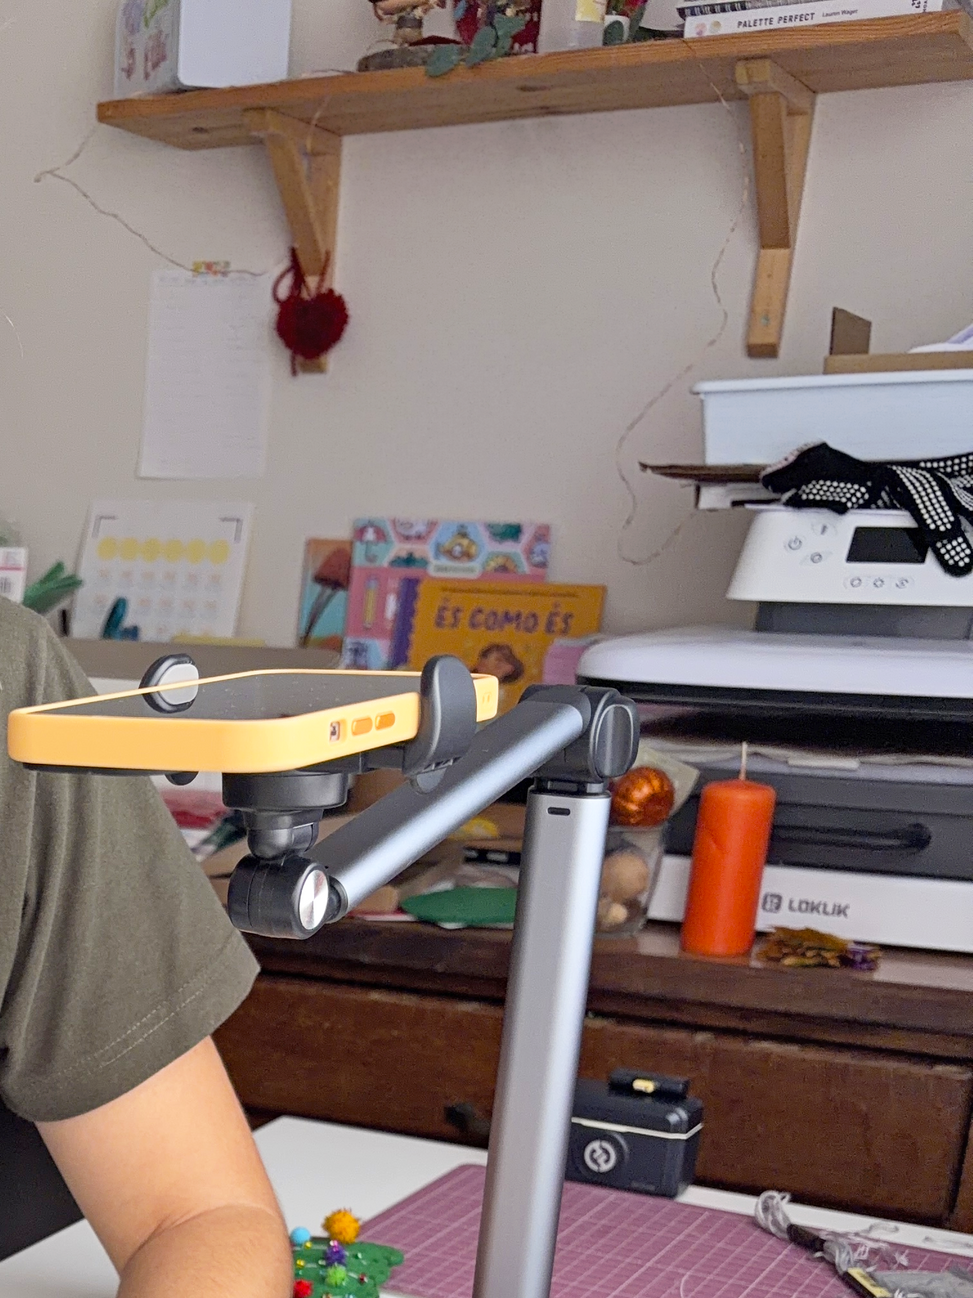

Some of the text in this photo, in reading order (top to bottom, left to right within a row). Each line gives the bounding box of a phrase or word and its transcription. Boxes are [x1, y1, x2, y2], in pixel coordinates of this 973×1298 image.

[737, 12, 815, 28] PALETTE PERFECT
[434, 597, 574, 636] ÉS COMO ÉS
[787, 898, 850, 918] LOKLIK
